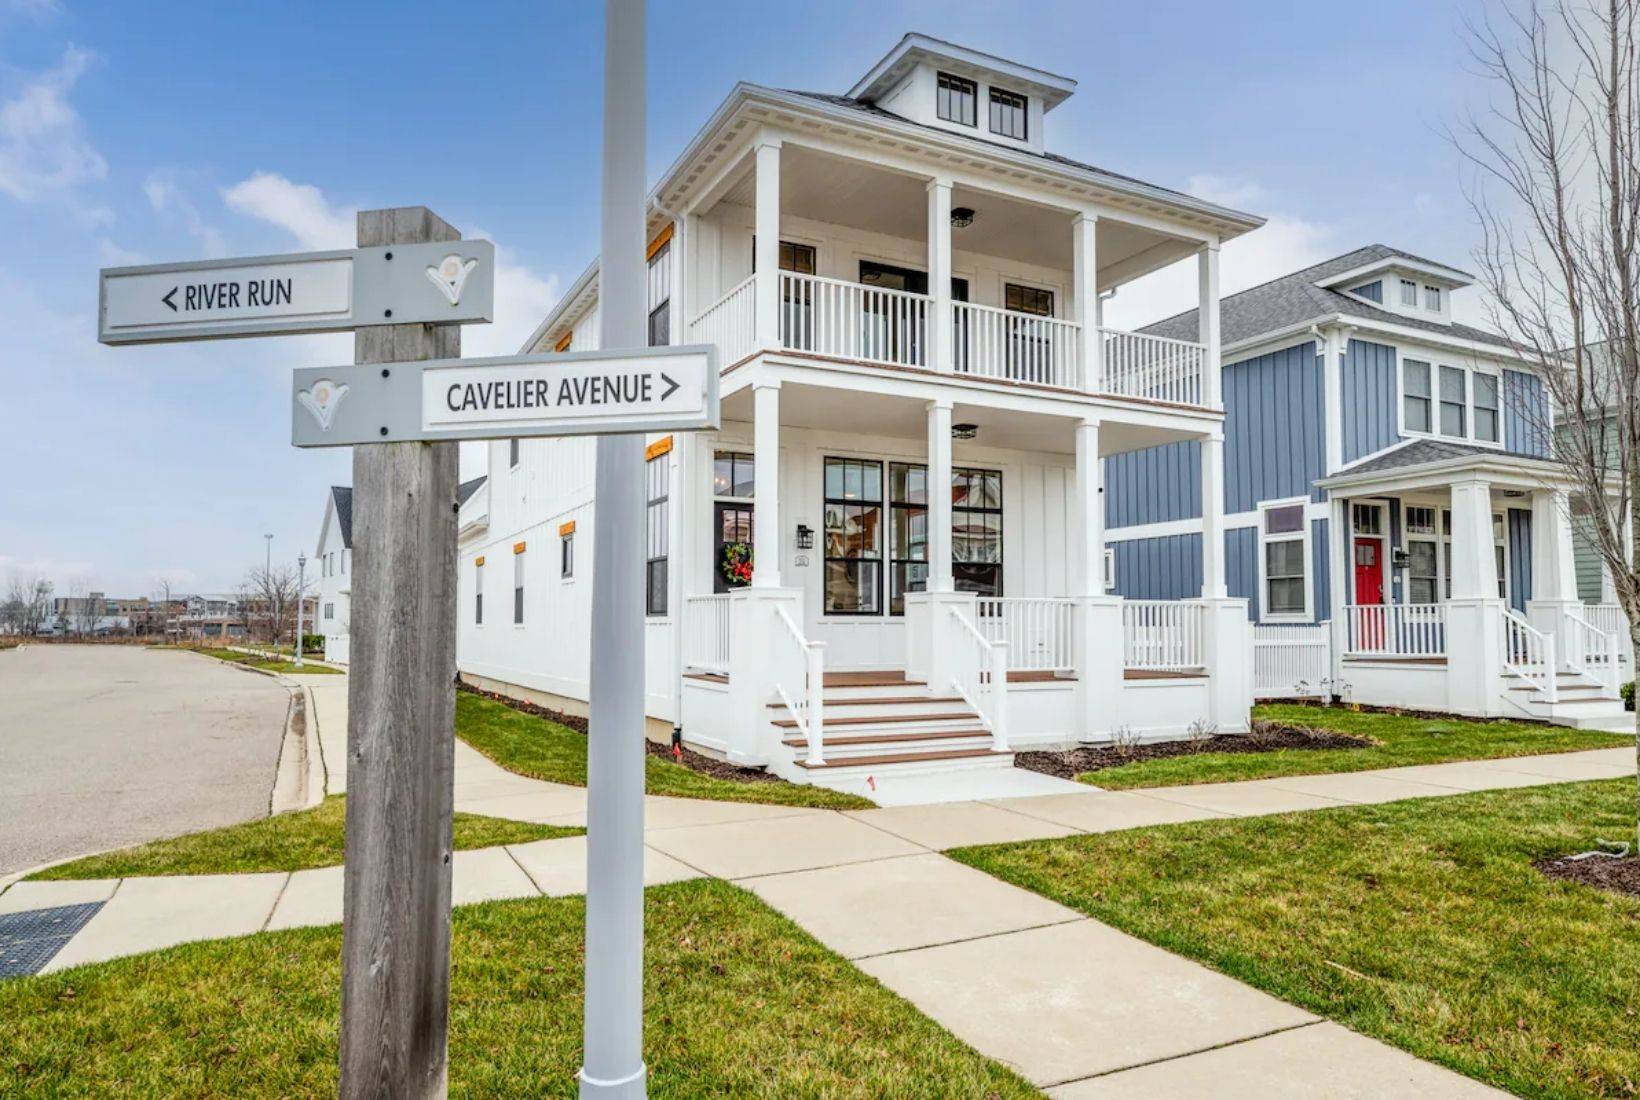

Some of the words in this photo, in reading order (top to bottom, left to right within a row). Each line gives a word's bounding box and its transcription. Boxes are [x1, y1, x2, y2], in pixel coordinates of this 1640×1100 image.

[185, 282, 241, 312] RIVER
[248, 277, 292, 307] RUN
[446, 379, 549, 413] CAVELIER
[556, 373, 652, 407] AVENUE
